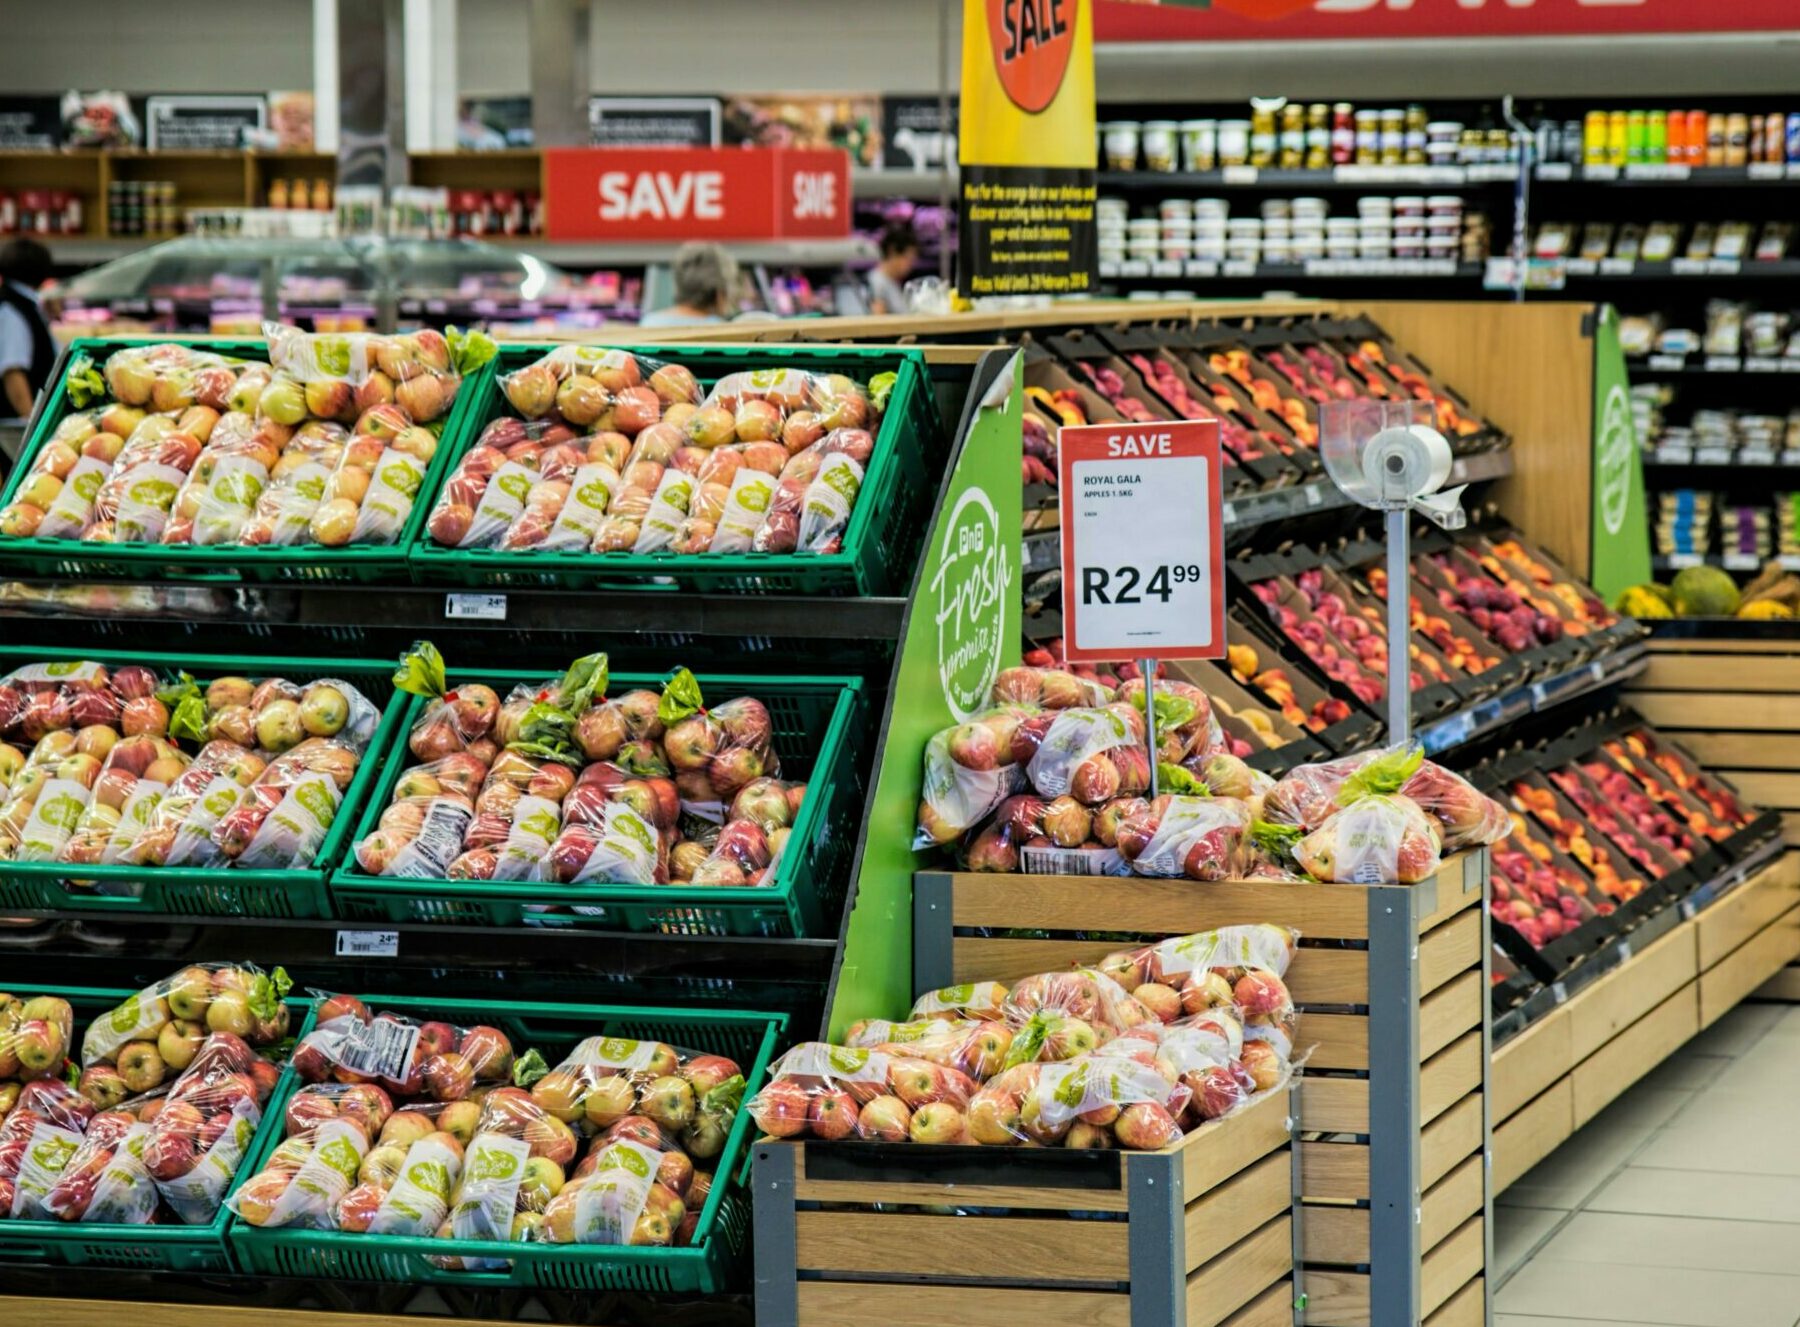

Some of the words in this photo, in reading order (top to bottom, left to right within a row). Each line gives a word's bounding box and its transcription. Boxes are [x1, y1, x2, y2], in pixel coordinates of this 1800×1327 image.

[1002, 0, 1067, 62] SALE
[598, 171, 725, 220] SAVE
[792, 171, 836, 219] SAVE
[1108, 433, 1172, 457] SAVE
[1084, 475, 1114, 486] ROYAL
[1117, 474, 1141, 485] GALA
[1084, 489, 1110, 498] APPLES
[960, 523, 984, 556] PnP
[931, 511, 1012, 641] Fresh
[945, 627, 988, 687] promise
